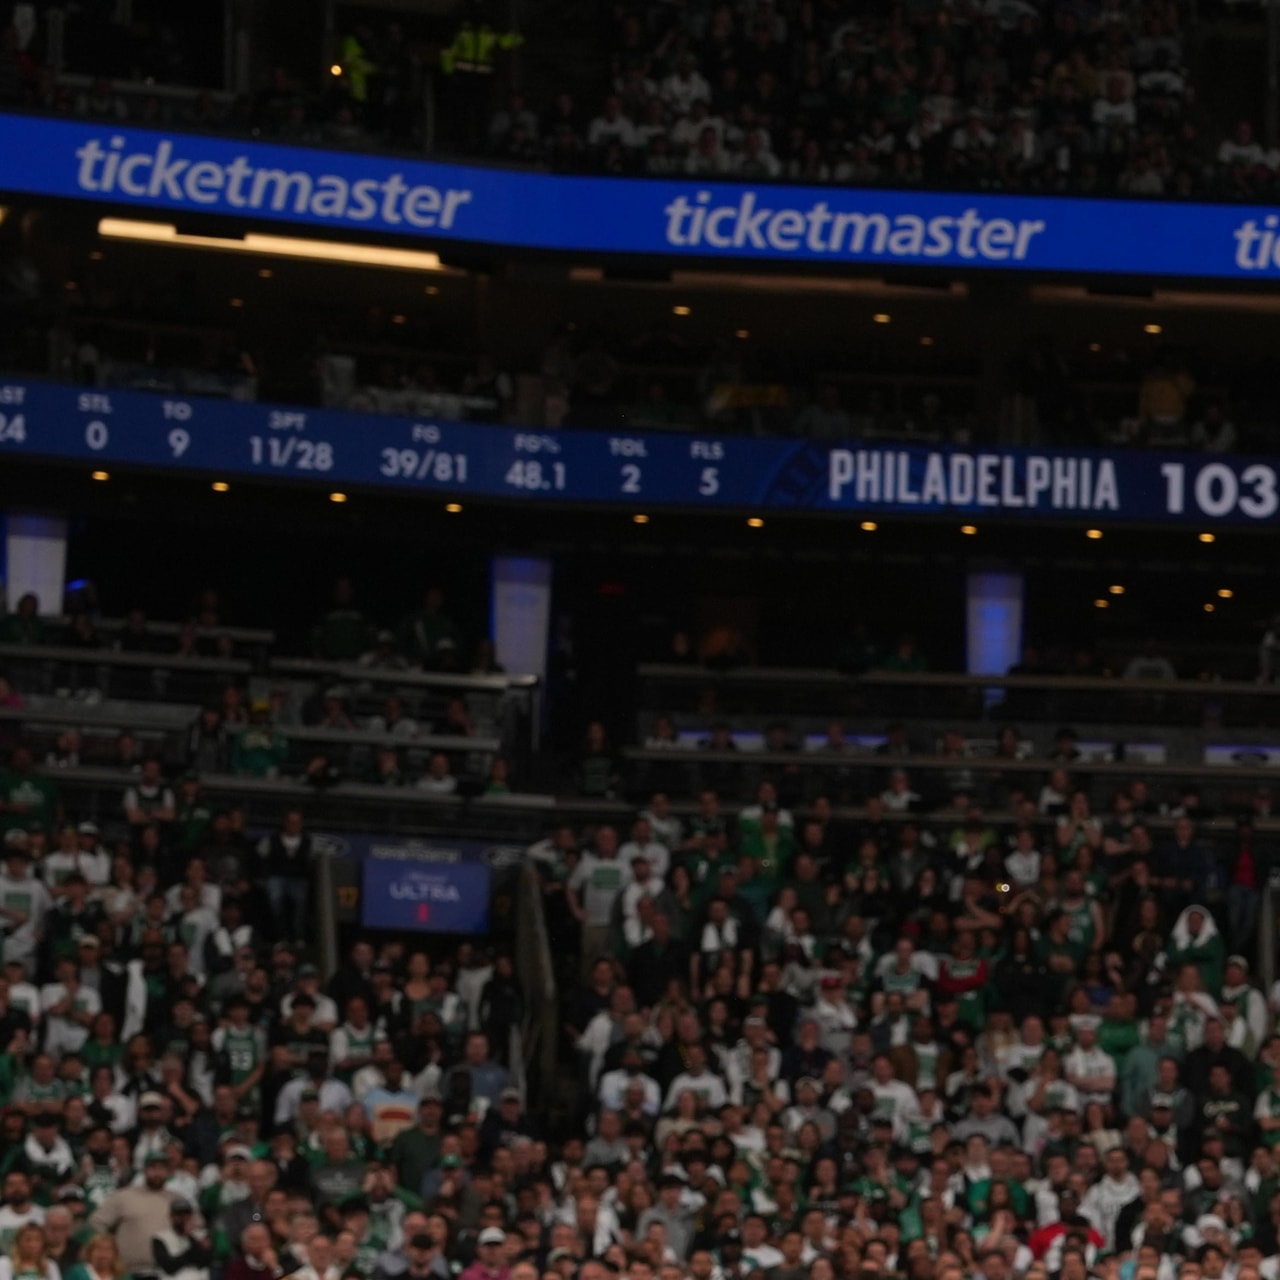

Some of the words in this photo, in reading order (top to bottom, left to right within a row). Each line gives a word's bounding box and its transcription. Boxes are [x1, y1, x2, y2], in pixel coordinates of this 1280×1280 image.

[77, 136, 471, 229] ticketmaster
[665, 191, 1045, 261] ticketmaster
[163, 401, 191, 420] TO
[86, 420, 108, 450] 0
[168, 429, 190, 457] 9
[250, 436, 334, 472] 11/28
[380, 448, 468, 482] 39/81
[505, 460, 566, 490] 48.1
[621, 465, 641, 493] 2
[701, 468, 720, 495] 5
[829, 450, 1119, 510] PHILADELPHIA
[1161, 463, 1279, 518] 103
